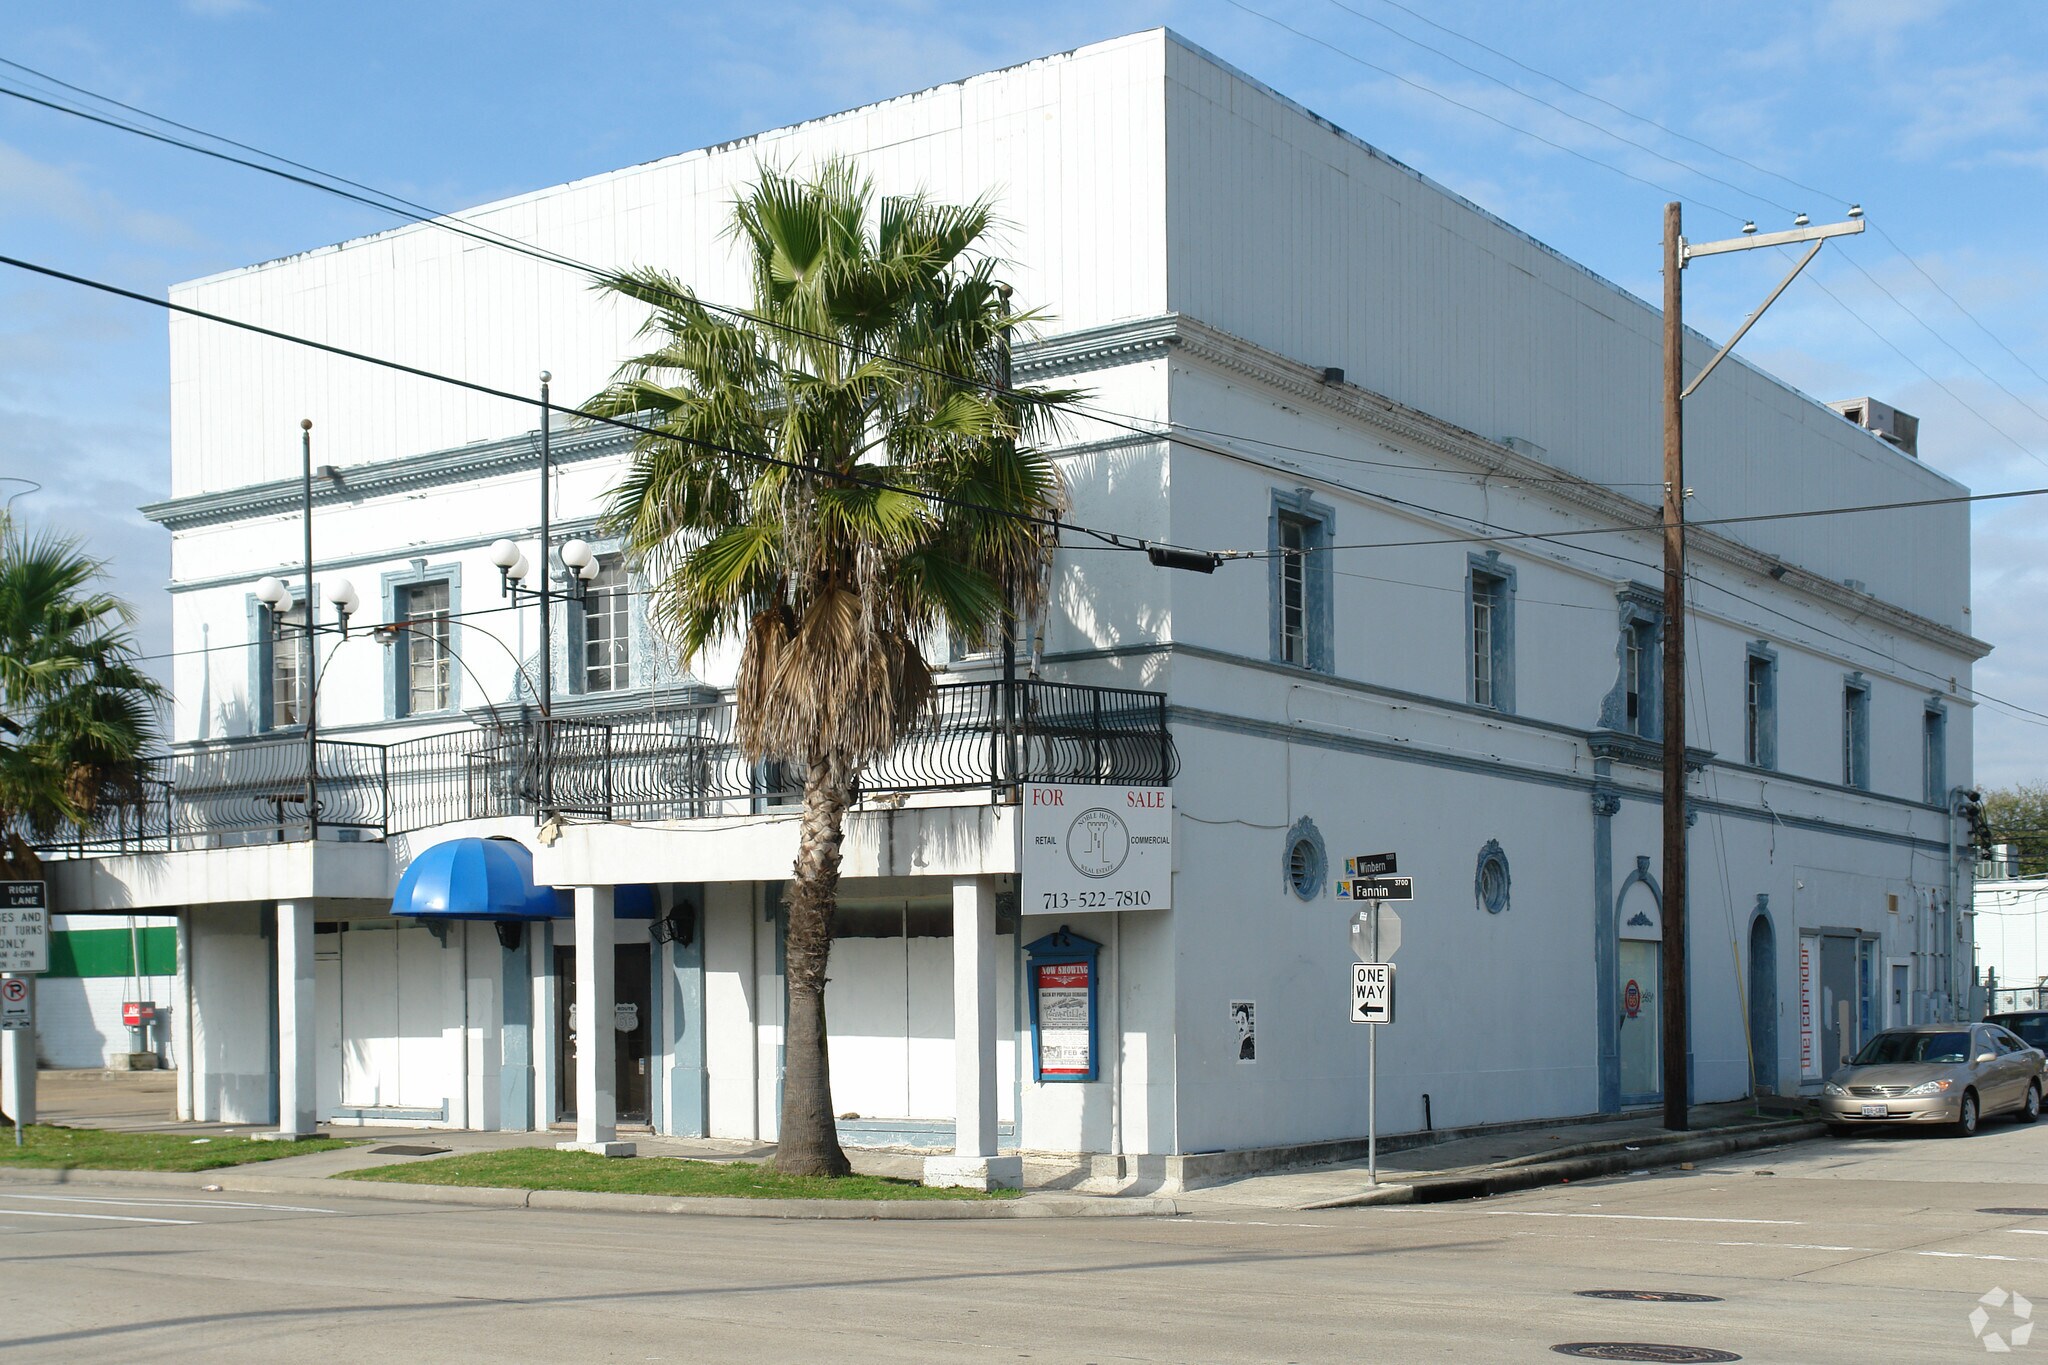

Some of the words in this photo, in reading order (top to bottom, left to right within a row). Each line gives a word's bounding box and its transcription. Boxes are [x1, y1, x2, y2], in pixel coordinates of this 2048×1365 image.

[1033, 789, 1064, 806] FOR
[1127, 791, 1165, 807] SALE
[1077, 812, 1097, 827] NOBLE
[1099, 812, 1119, 828] HOUSE
[1035, 836, 1056, 845] RETAIL
[1130, 836, 1170, 845] COMMERCIAL
[1080, 864, 1096, 874] REAL
[1095, 864, 1114, 875] ESTATE
[8, 885, 39, 895] RIGHT
[1356, 884, 1389, 897] Fannin
[10, 896, 38, 905] LANE
[1042, 889, 1151, 910] 713-522-7810
[0, 912, 14, 923] ES
[21, 912, 41, 923] AND
[15, 925, 42, 936] TURNS
[1042, 966, 1057, 975] NOW
[1058, 965, 1088, 975] SHOWING
[1357, 968, 1385, 983] ONE
[1356, 985, 1386, 999] WAY
[128, 1006, 139, 1015] Air
